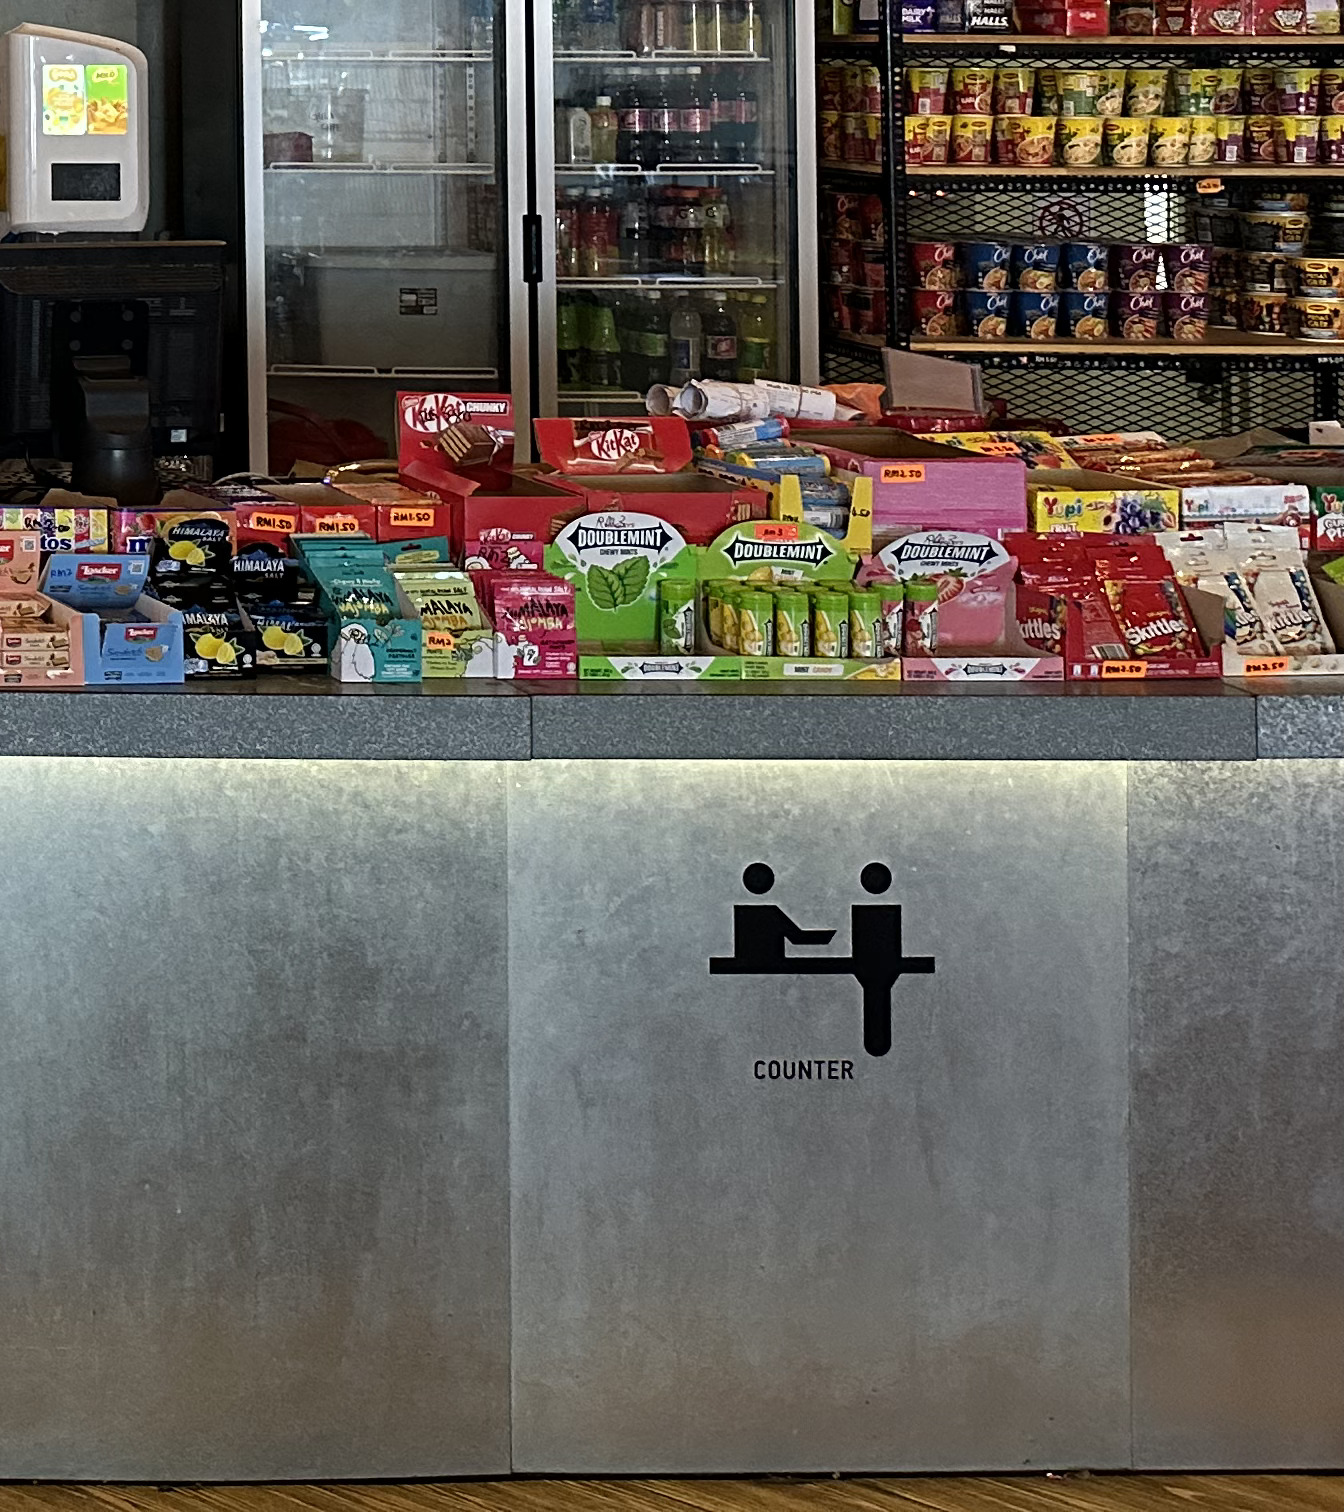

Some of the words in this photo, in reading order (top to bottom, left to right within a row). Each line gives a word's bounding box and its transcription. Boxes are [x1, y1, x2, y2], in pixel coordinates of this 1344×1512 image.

[466, 401, 506, 414] CHUNKY
[597, 429, 637, 459] KitKat
[1043, 496, 1084, 519] Yupi
[172, 526, 225, 538] HIMALAYA
[578, 528, 663, 547] DOUBLEMINT
[40, 537, 73, 552] tos
[733, 542, 824, 561] DOUBLEMINT
[900, 544, 991, 561] DOUBLEMINT
[82, 564, 120, 576] Loacker
[233, 559, 285, 572] HIMALAYA
[420, 599, 474, 617] MALAYA
[1017, 618, 1062, 639] kittles
[753, 1060, 854, 1080] COUNTER
